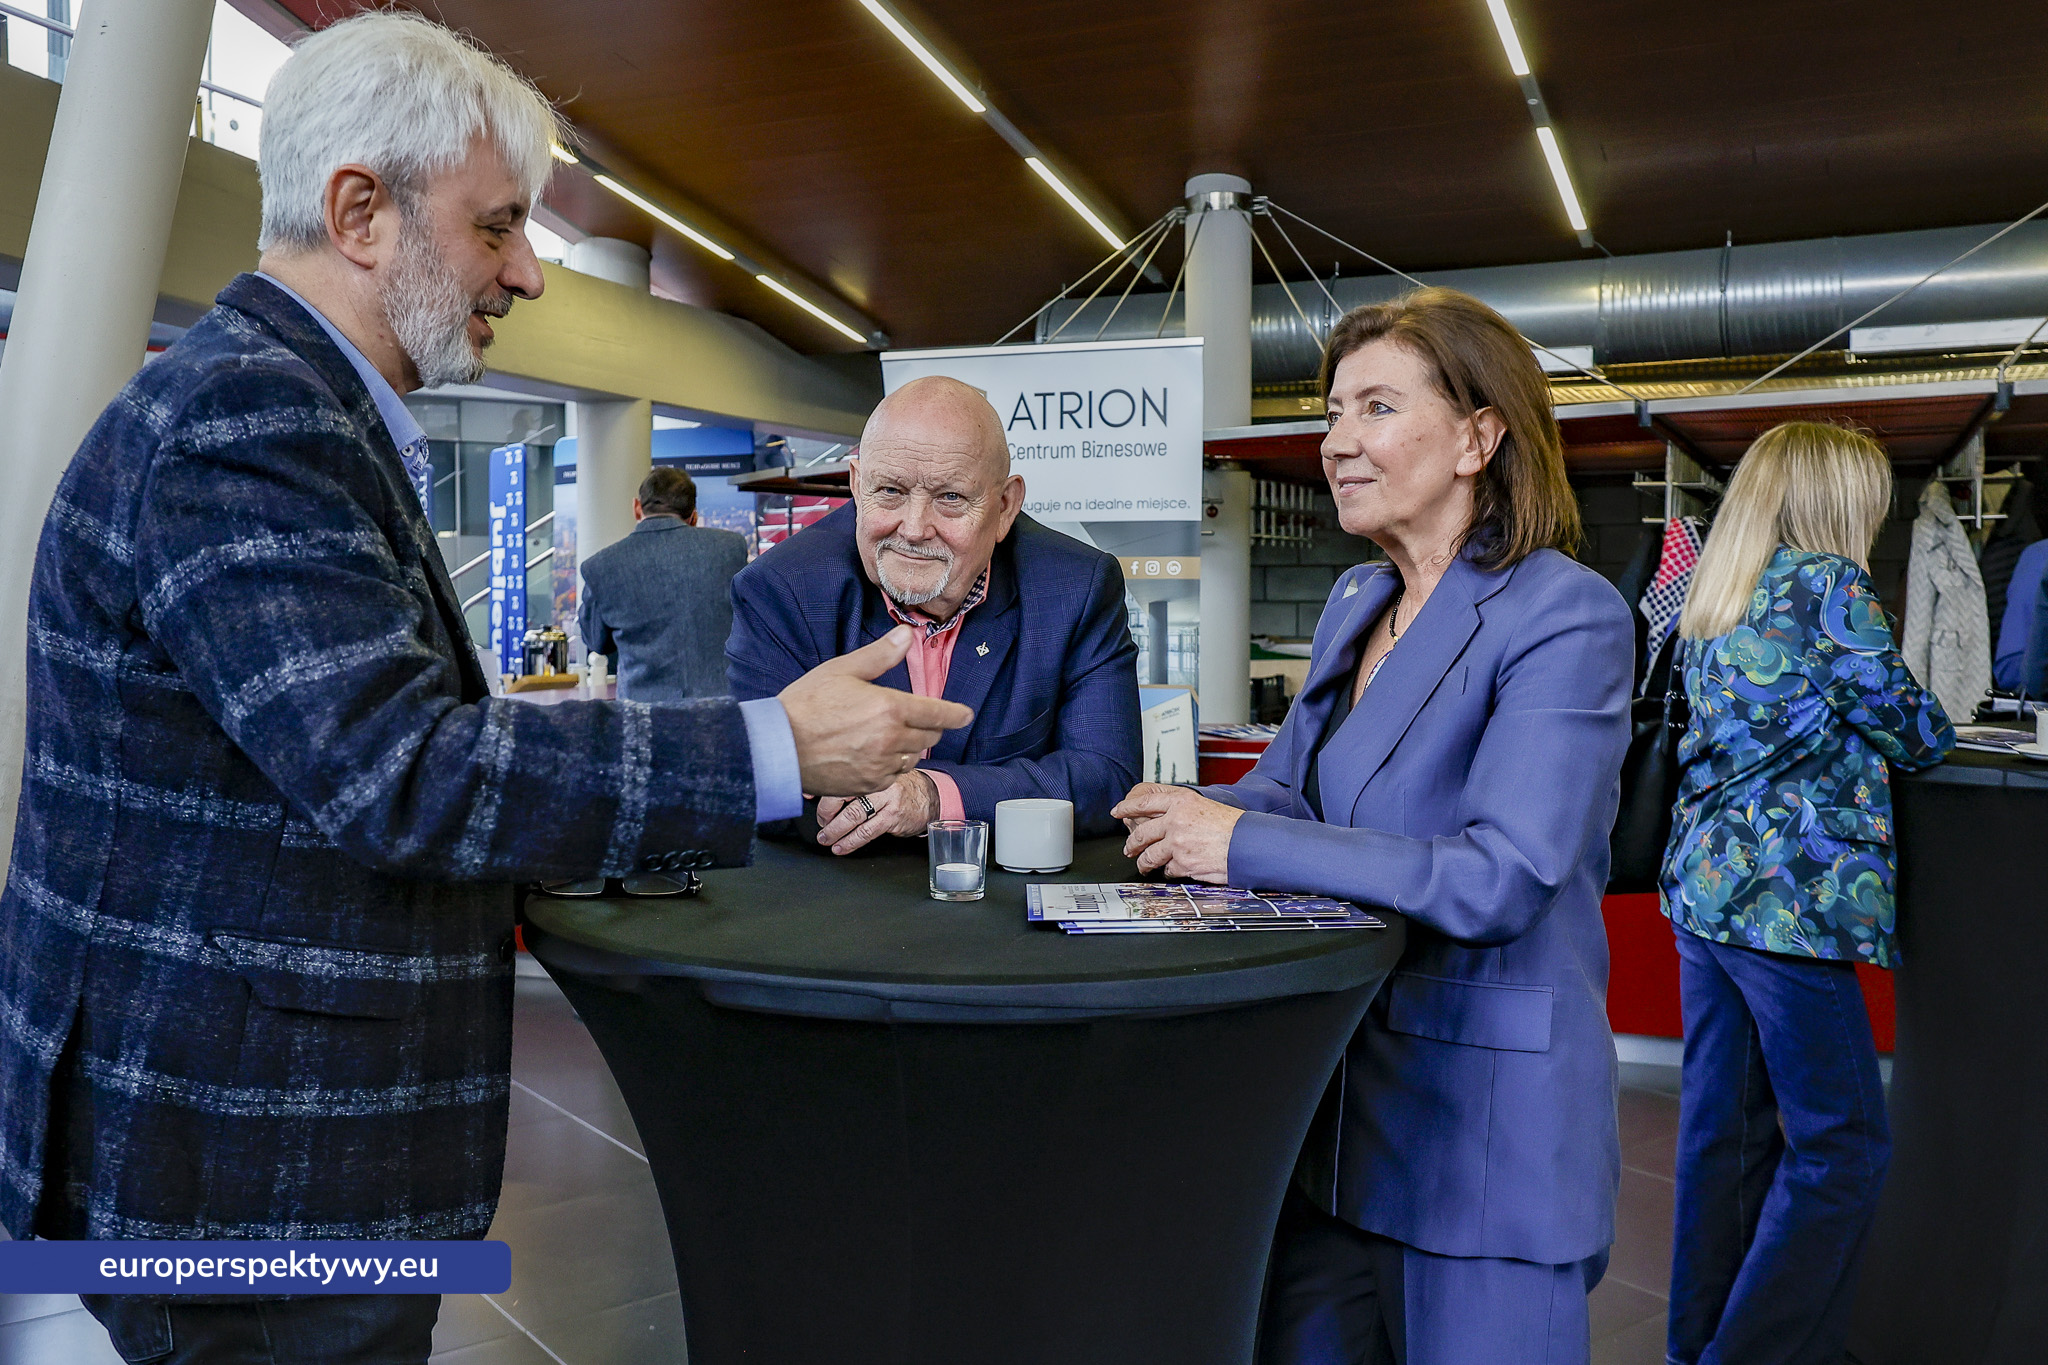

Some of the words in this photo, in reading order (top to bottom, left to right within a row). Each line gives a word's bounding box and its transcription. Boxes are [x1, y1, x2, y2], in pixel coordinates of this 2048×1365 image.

[1007, 387, 1168, 431] ATRION
[1008, 442, 1076, 460] Centrum
[1082, 440, 1167, 459] Biznesowe
[1064, 501, 1082, 511] na
[1085, 498, 1133, 510] idealne
[1136, 498, 1191, 511] miejsce.
[489, 501, 507, 672] jubileu
